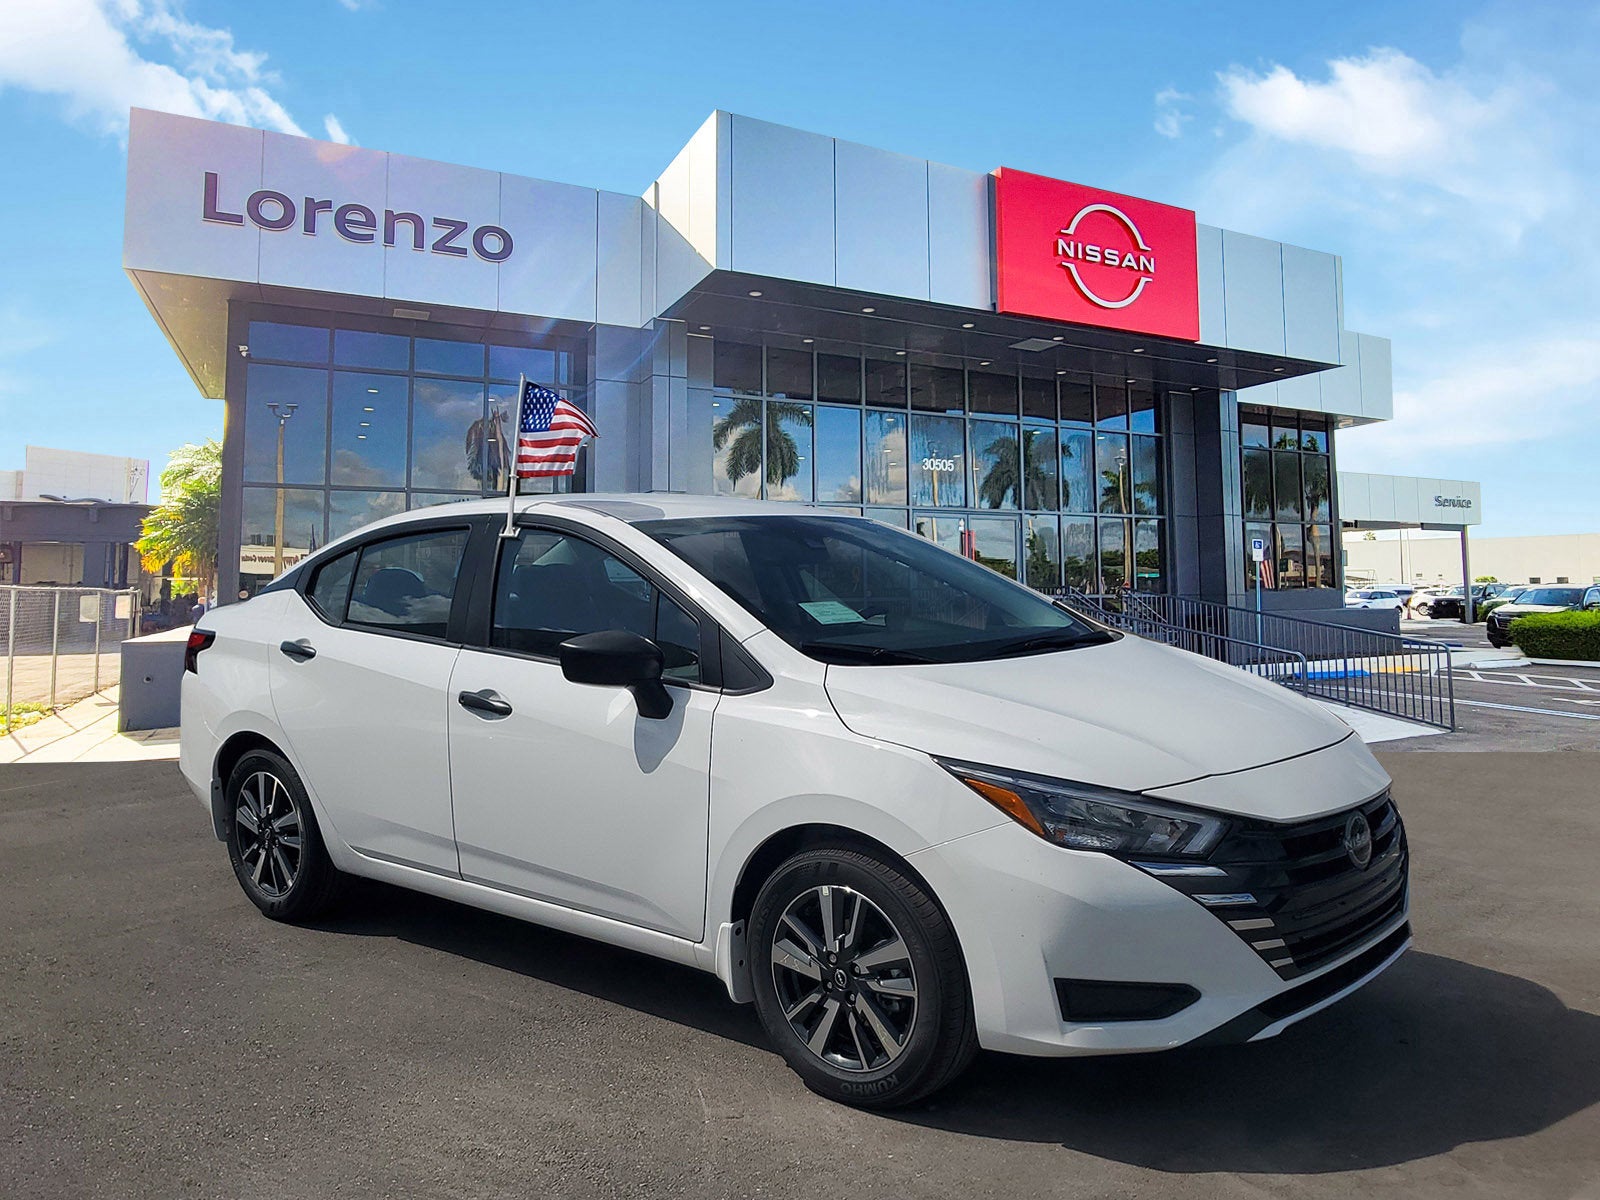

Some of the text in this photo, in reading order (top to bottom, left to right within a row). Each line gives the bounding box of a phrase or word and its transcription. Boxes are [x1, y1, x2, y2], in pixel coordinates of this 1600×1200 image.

[202, 171, 515, 263] Lorenzo
[1057, 238, 1155, 273] NISSAN
[922, 458, 955, 471] 30505
[1433, 495, 1472, 508] Service
[840, 1074, 899, 1097] KUMHO
